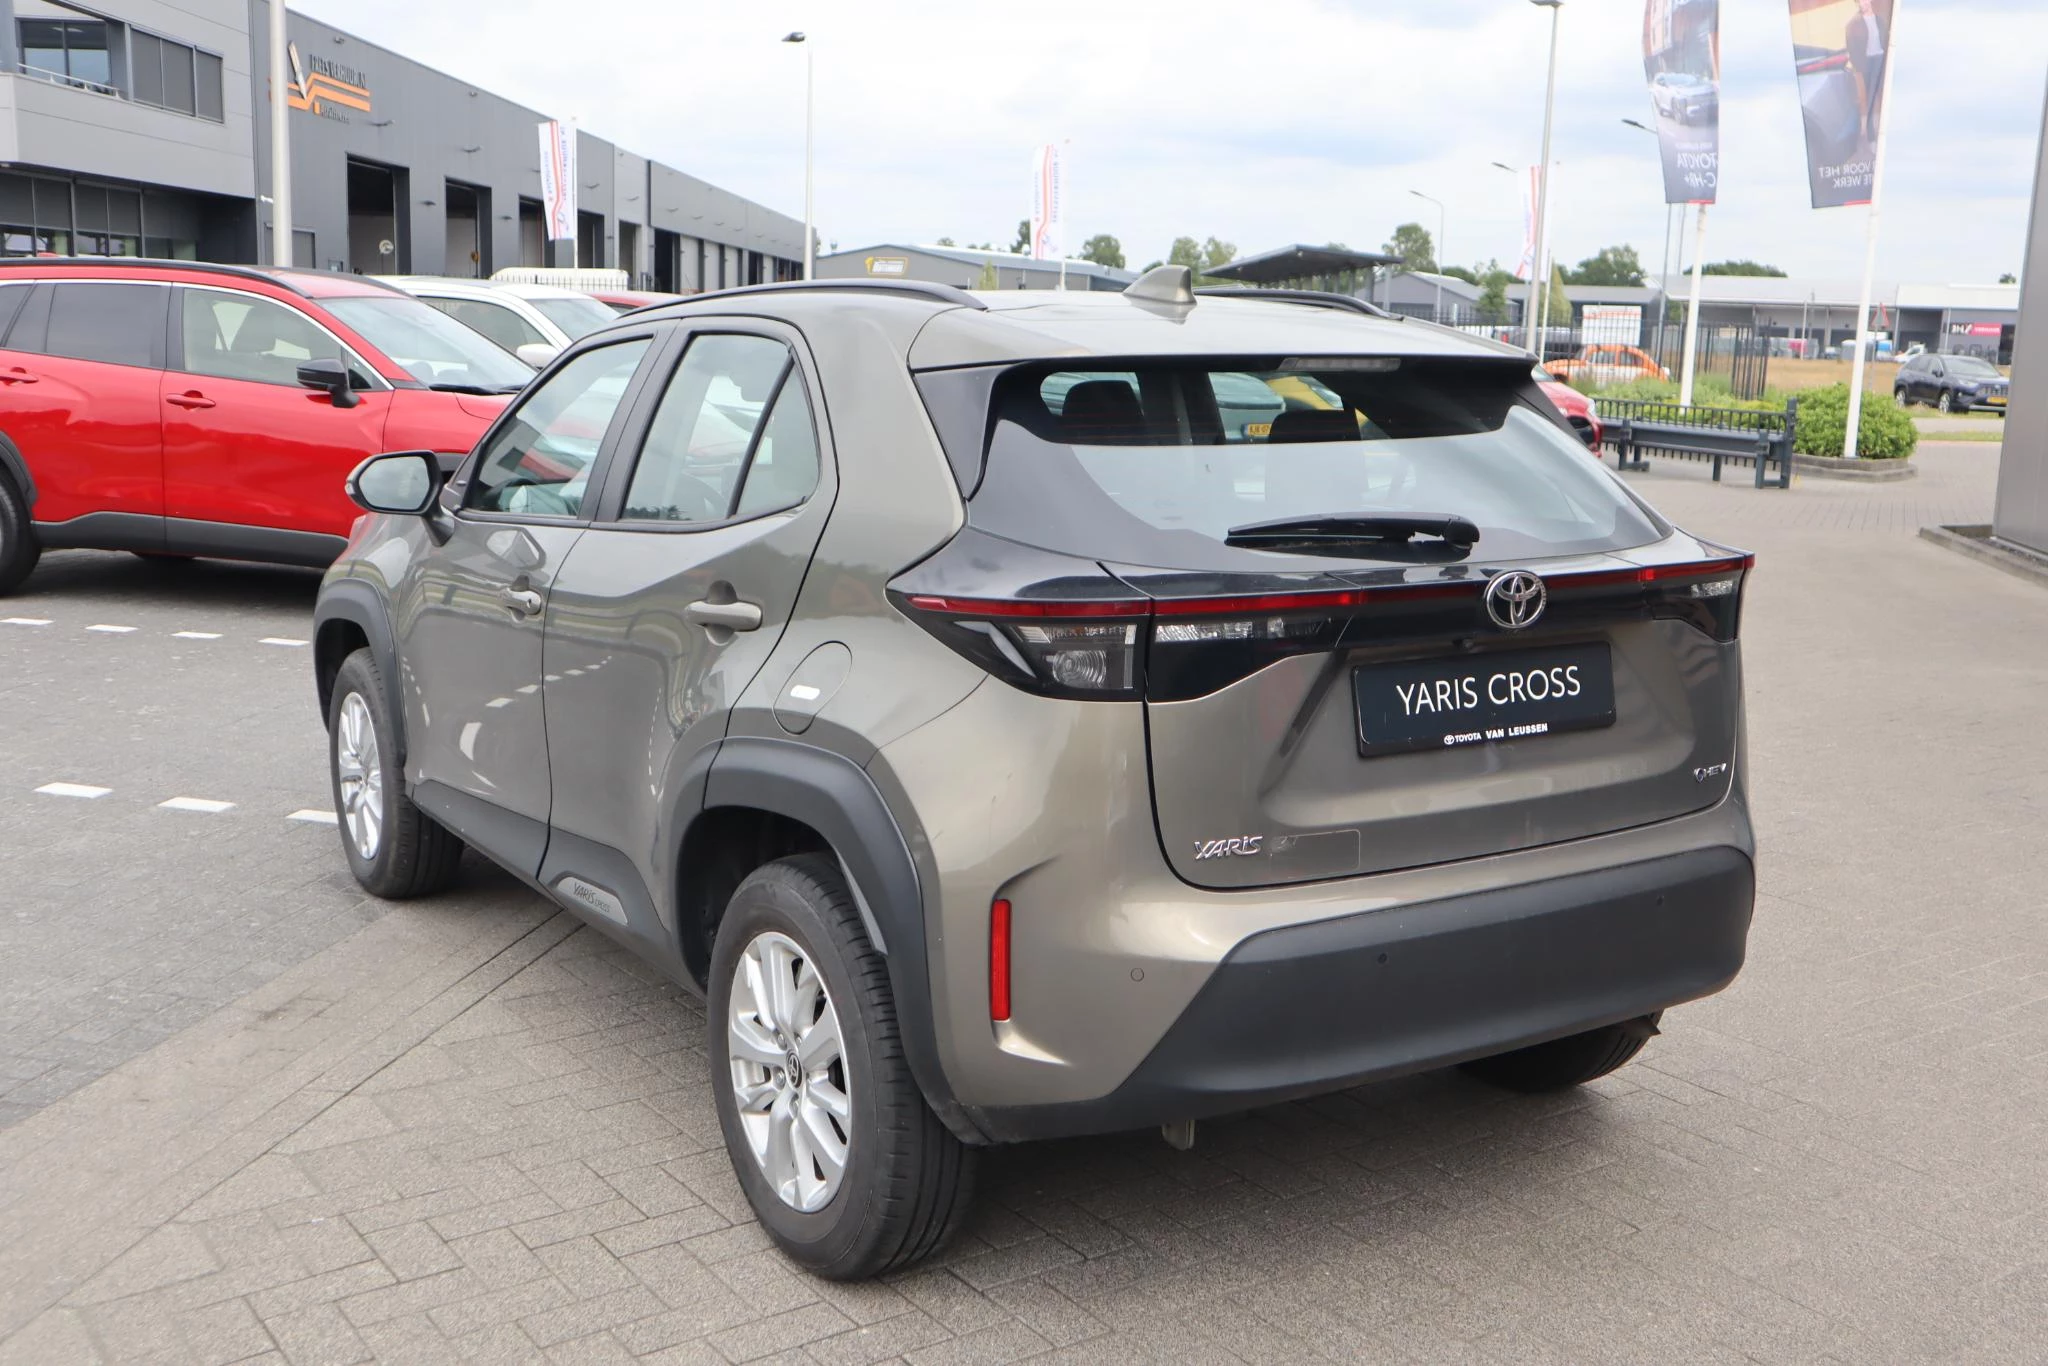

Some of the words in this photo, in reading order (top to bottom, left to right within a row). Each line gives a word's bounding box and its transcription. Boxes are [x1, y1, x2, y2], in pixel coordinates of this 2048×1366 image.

[1396, 676, 1478, 716] YARIS
[1488, 665, 1581, 705] CROSS
[1455, 732, 1482, 743] TOYOTA
[1485, 728, 1504, 739] VAN
[1508, 723, 1548, 736] LEUSSEN
